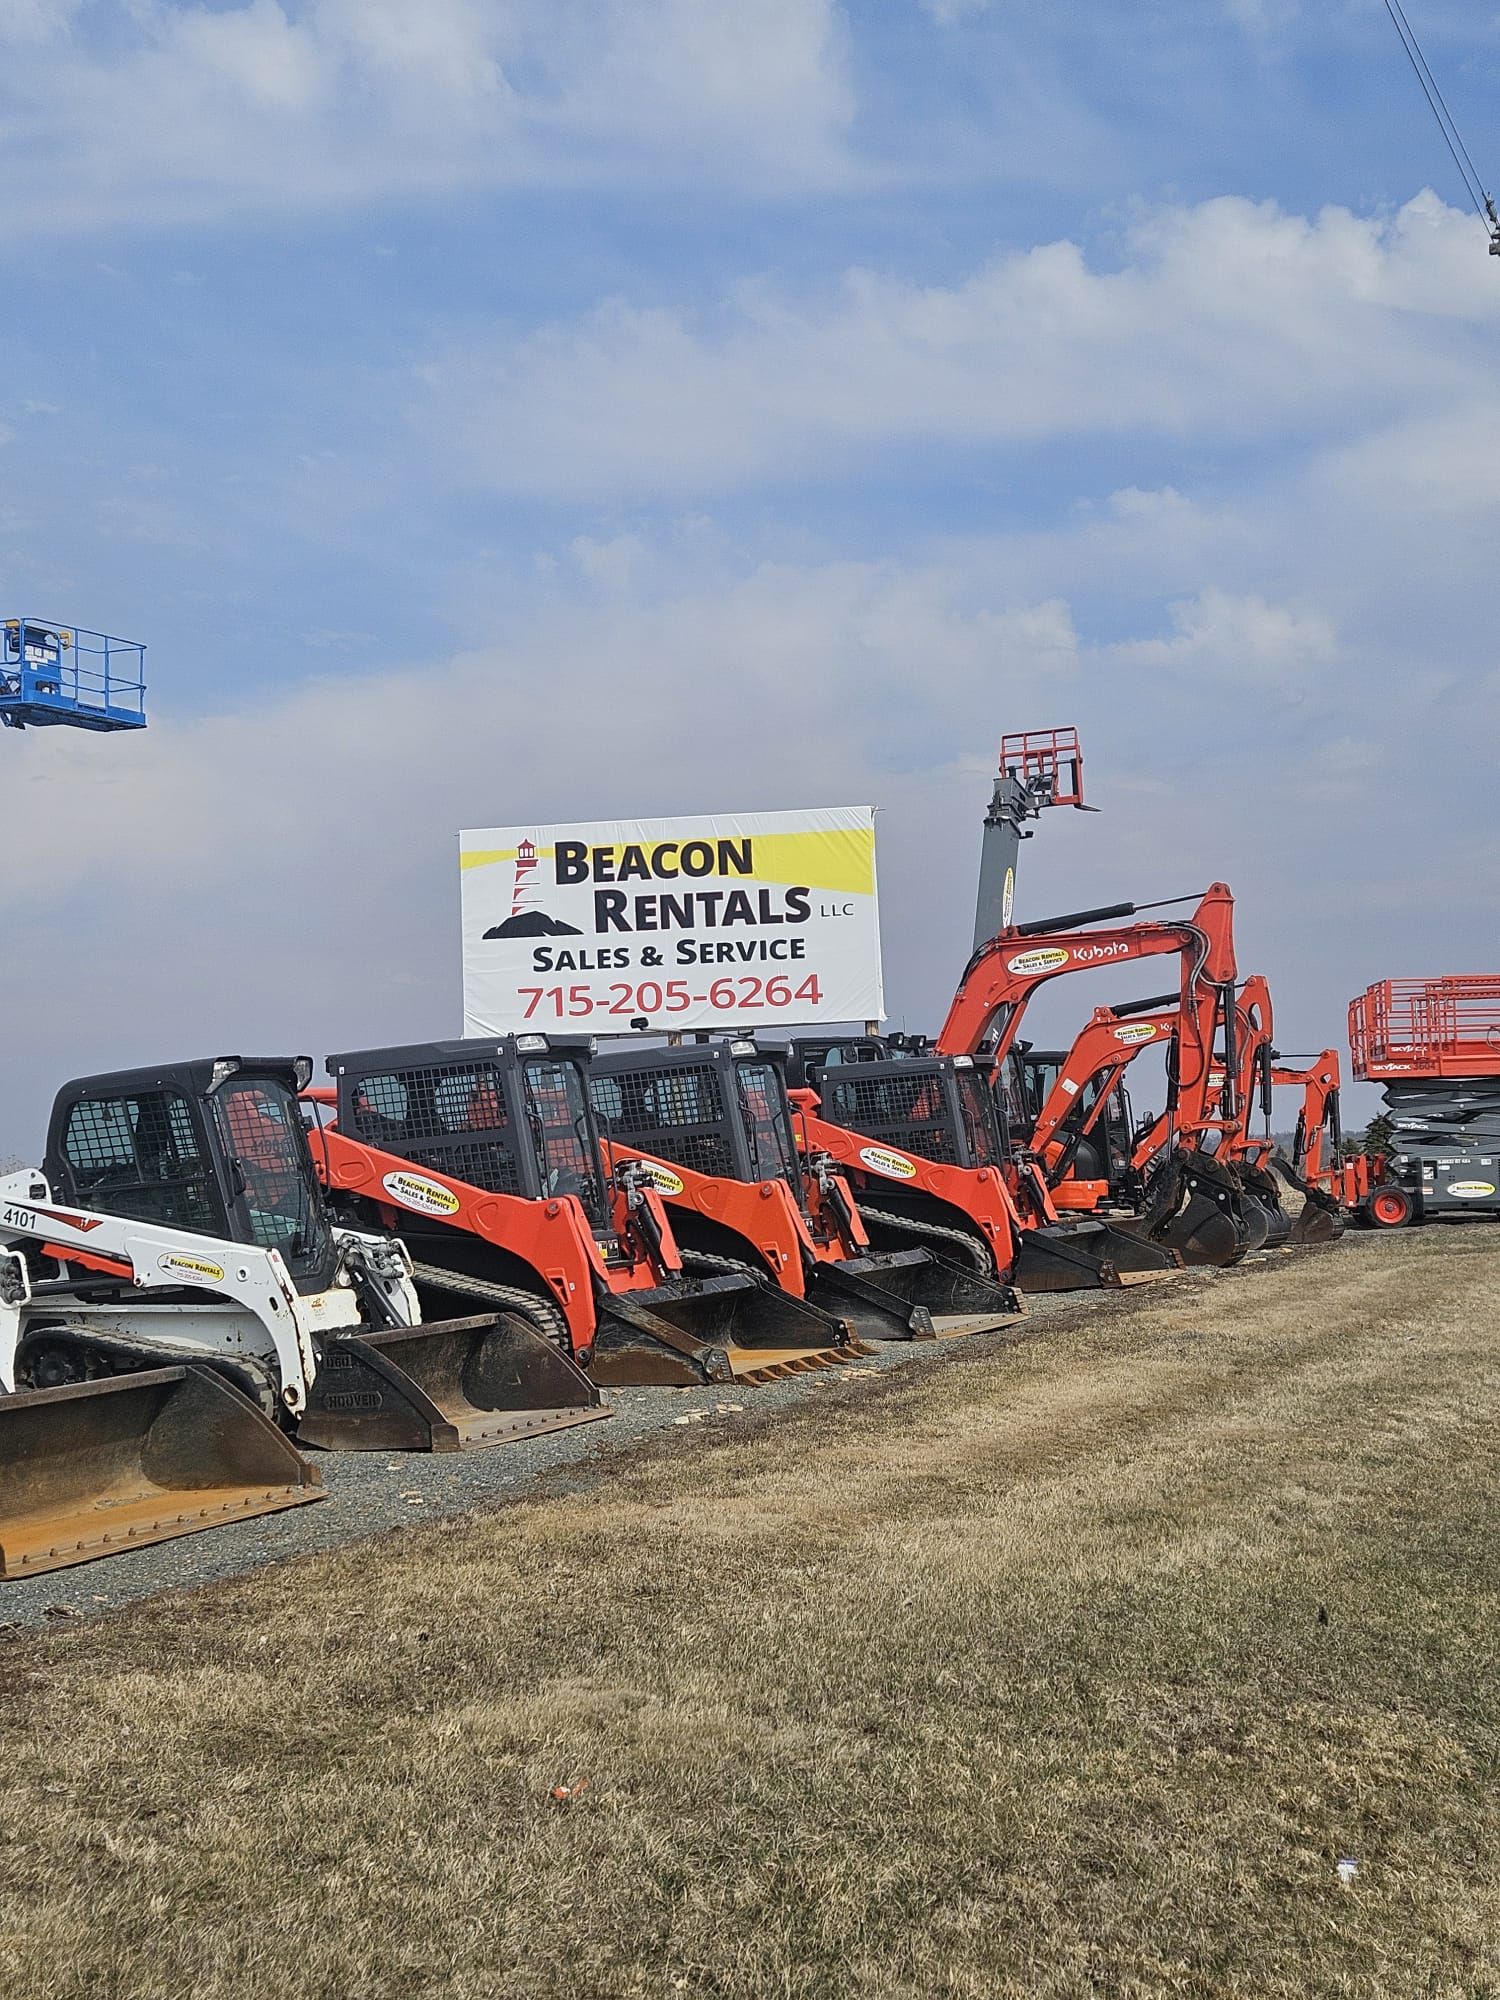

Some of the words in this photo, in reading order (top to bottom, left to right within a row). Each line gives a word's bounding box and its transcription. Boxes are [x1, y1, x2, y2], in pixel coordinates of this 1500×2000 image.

[555, 839, 753, 885] BEACON
[594, 887, 812, 934] RENTALS
[820, 903, 854, 917] LLC
[533, 946, 630, 972] SALES
[640, 946, 664, 967] &
[676, 939, 806, 965] SERVICE
[1041, 951, 1065, 960] RENTALS
[1073, 941, 1129, 961] Kubota
[517, 974, 824, 1018] 715-205-6264
[1372, 1063, 1411, 1071] SKYJACK
[870, 1151, 891, 1162] BEACON
[891, 1159, 914, 1171] RENTALS
[654, 1172, 681, 1186] RENTALS
[397, 1177, 425, 1193] BEACON
[426, 1188, 456, 1205] RENTALS
[400, 1187, 419, 1199] SALES
[426, 1196, 450, 1210] SERVICE
[3, 1208, 36, 1229] 4101
[170, 1258, 194, 1270] BEACON
[195, 1263, 220, 1275] RENTALS
